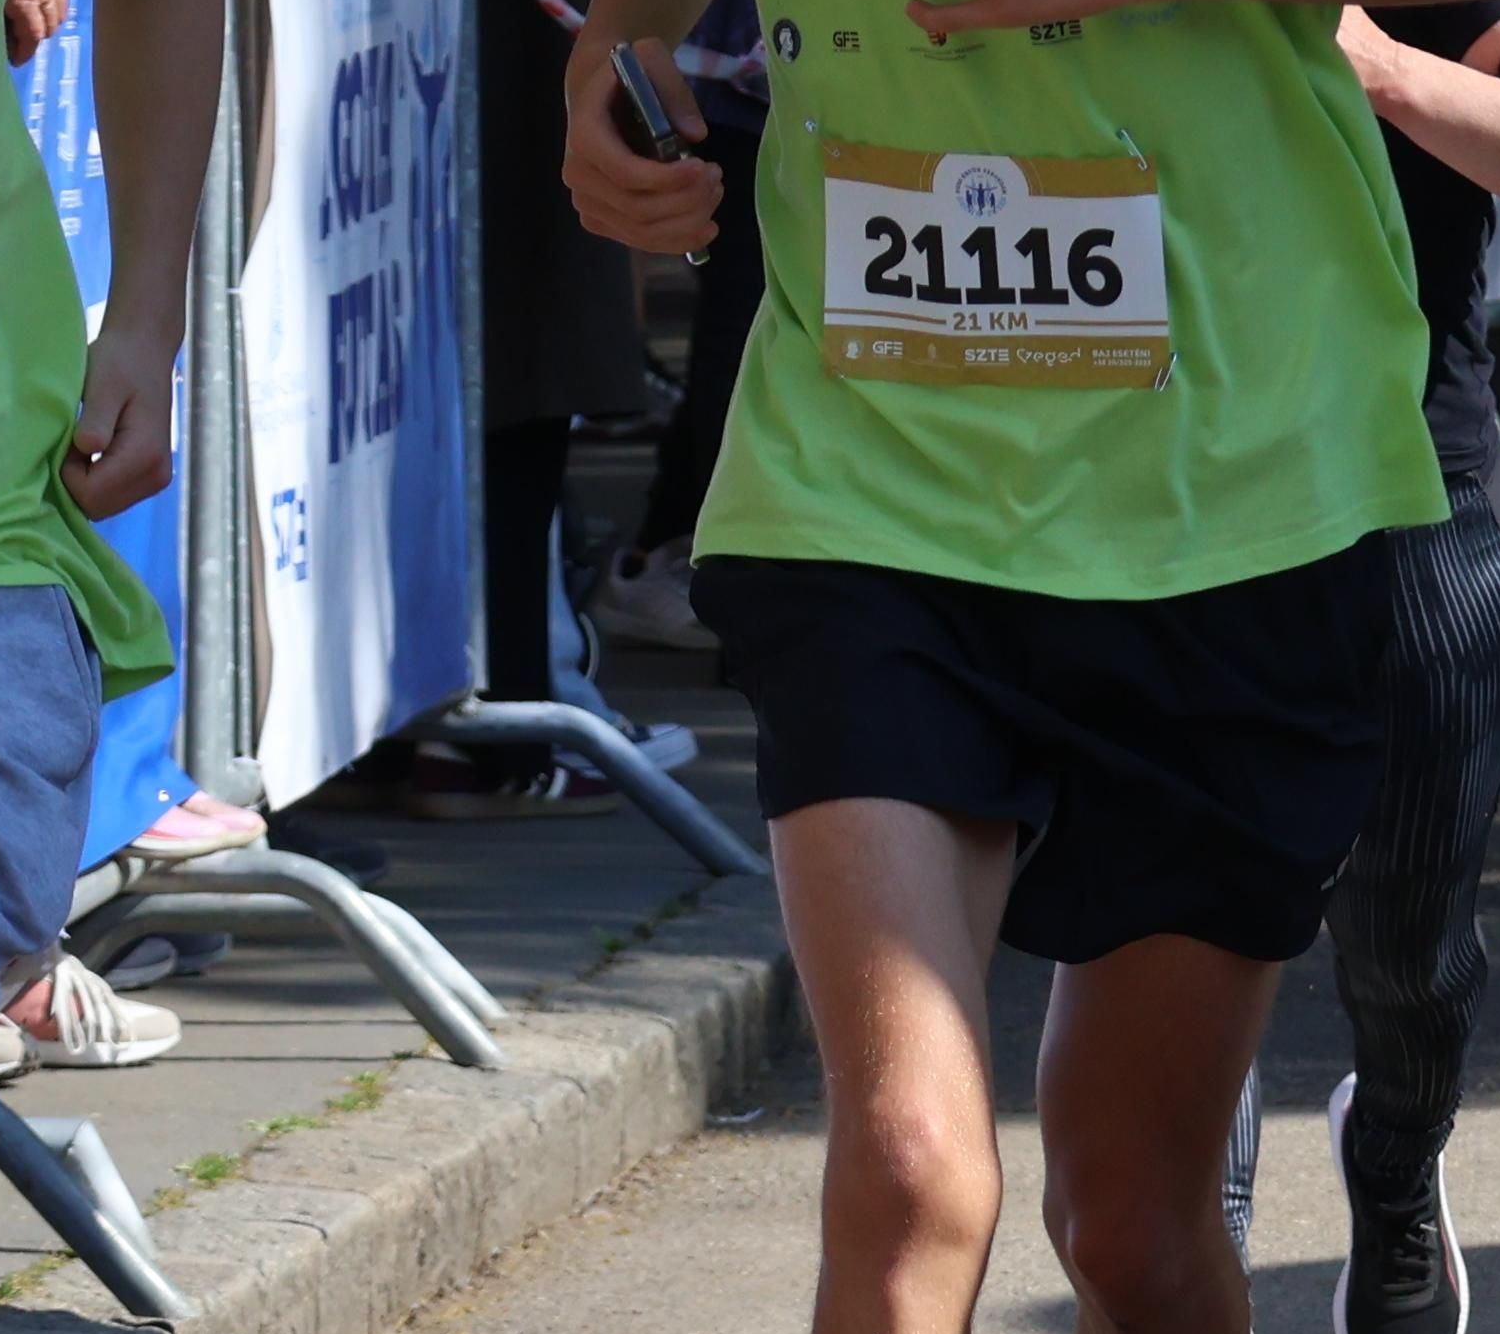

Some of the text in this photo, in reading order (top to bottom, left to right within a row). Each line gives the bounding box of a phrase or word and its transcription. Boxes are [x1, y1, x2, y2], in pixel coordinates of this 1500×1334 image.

[1029, 19, 1083, 41] SZTE
[833, 31, 860, 48] GFE
[864, 216, 1123, 306] 21116
[953, 312, 1028, 331] 21 KM
[872, 341, 903, 355] GFE
[965, 349, 1010, 362] SZTE
